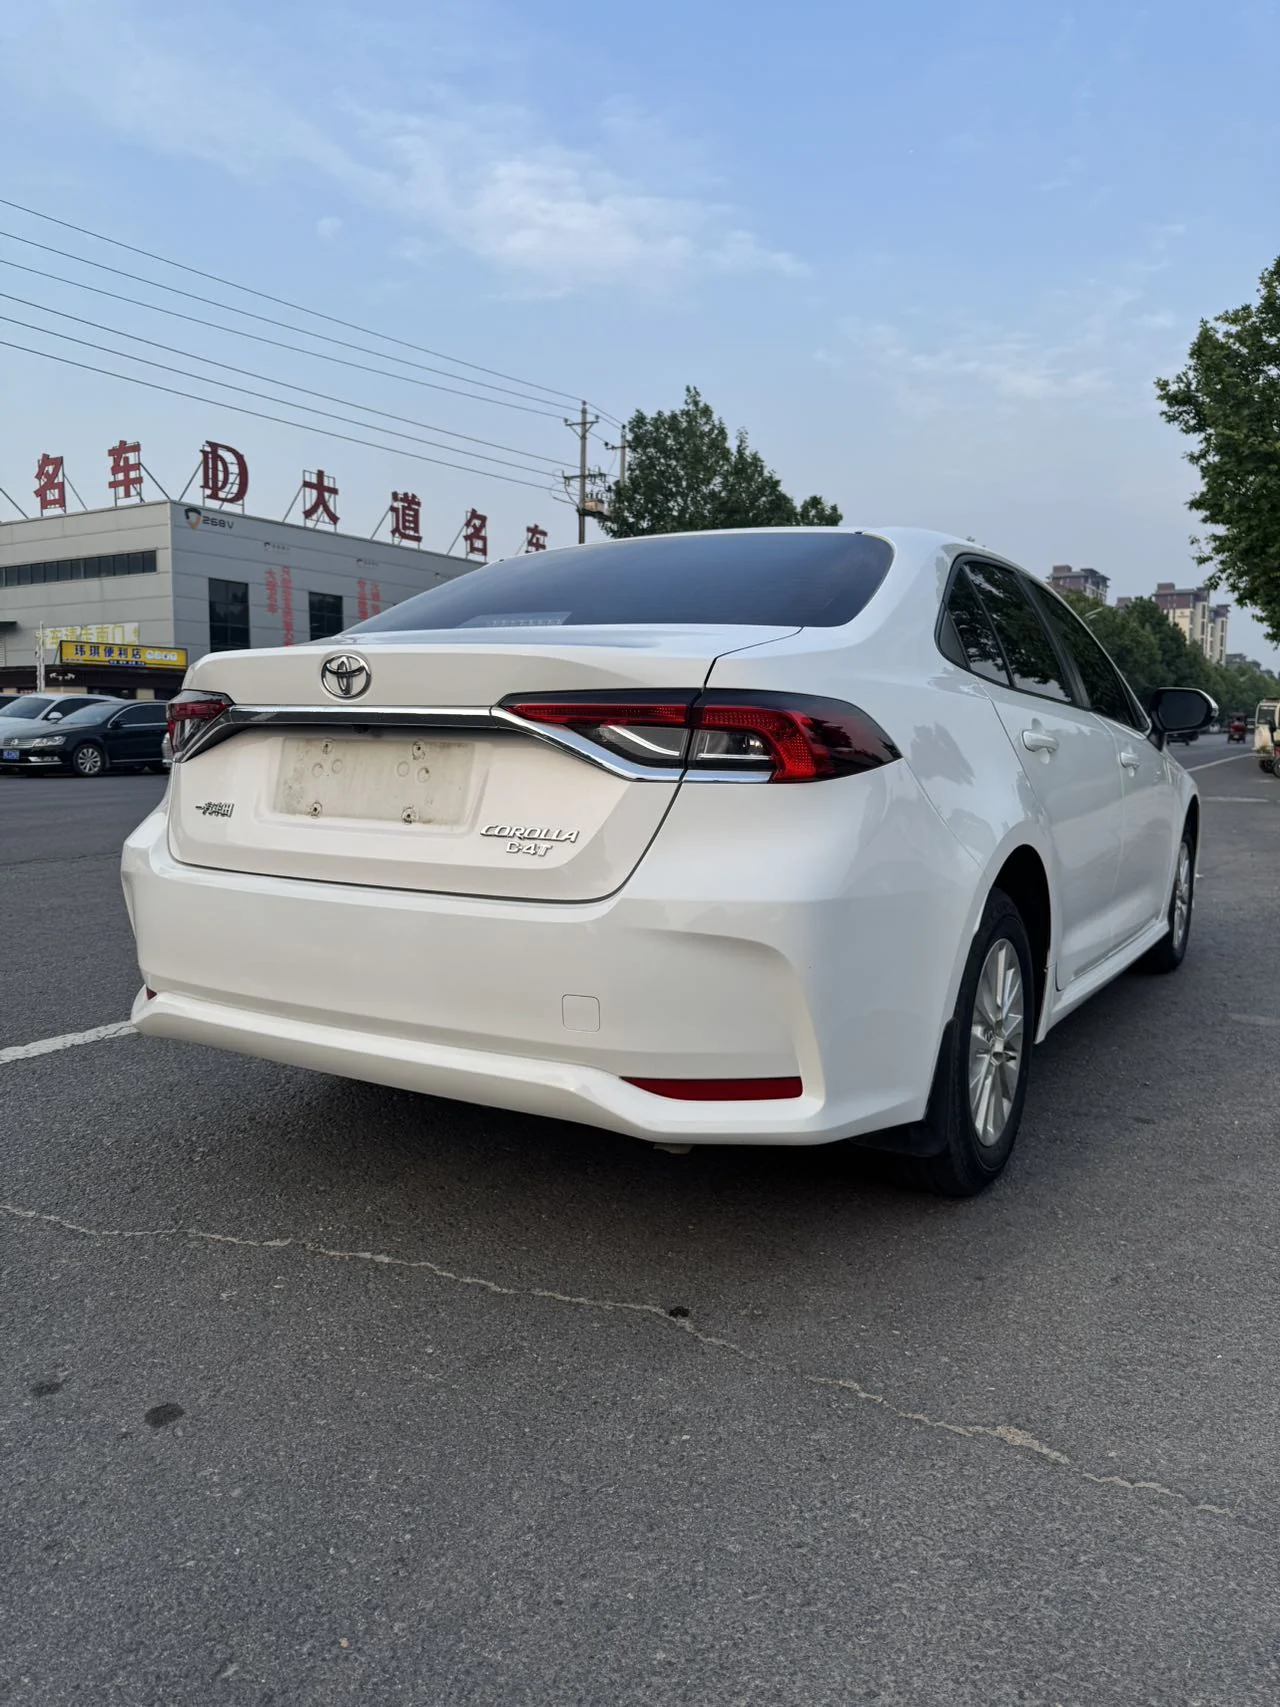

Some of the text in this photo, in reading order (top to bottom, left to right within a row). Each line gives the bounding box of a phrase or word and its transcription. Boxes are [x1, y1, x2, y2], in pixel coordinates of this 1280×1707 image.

[33, 439, 144, 510] 名车
[302, 469, 548, 556] 大道名车
[480, 824, 580, 843] COROLLA
